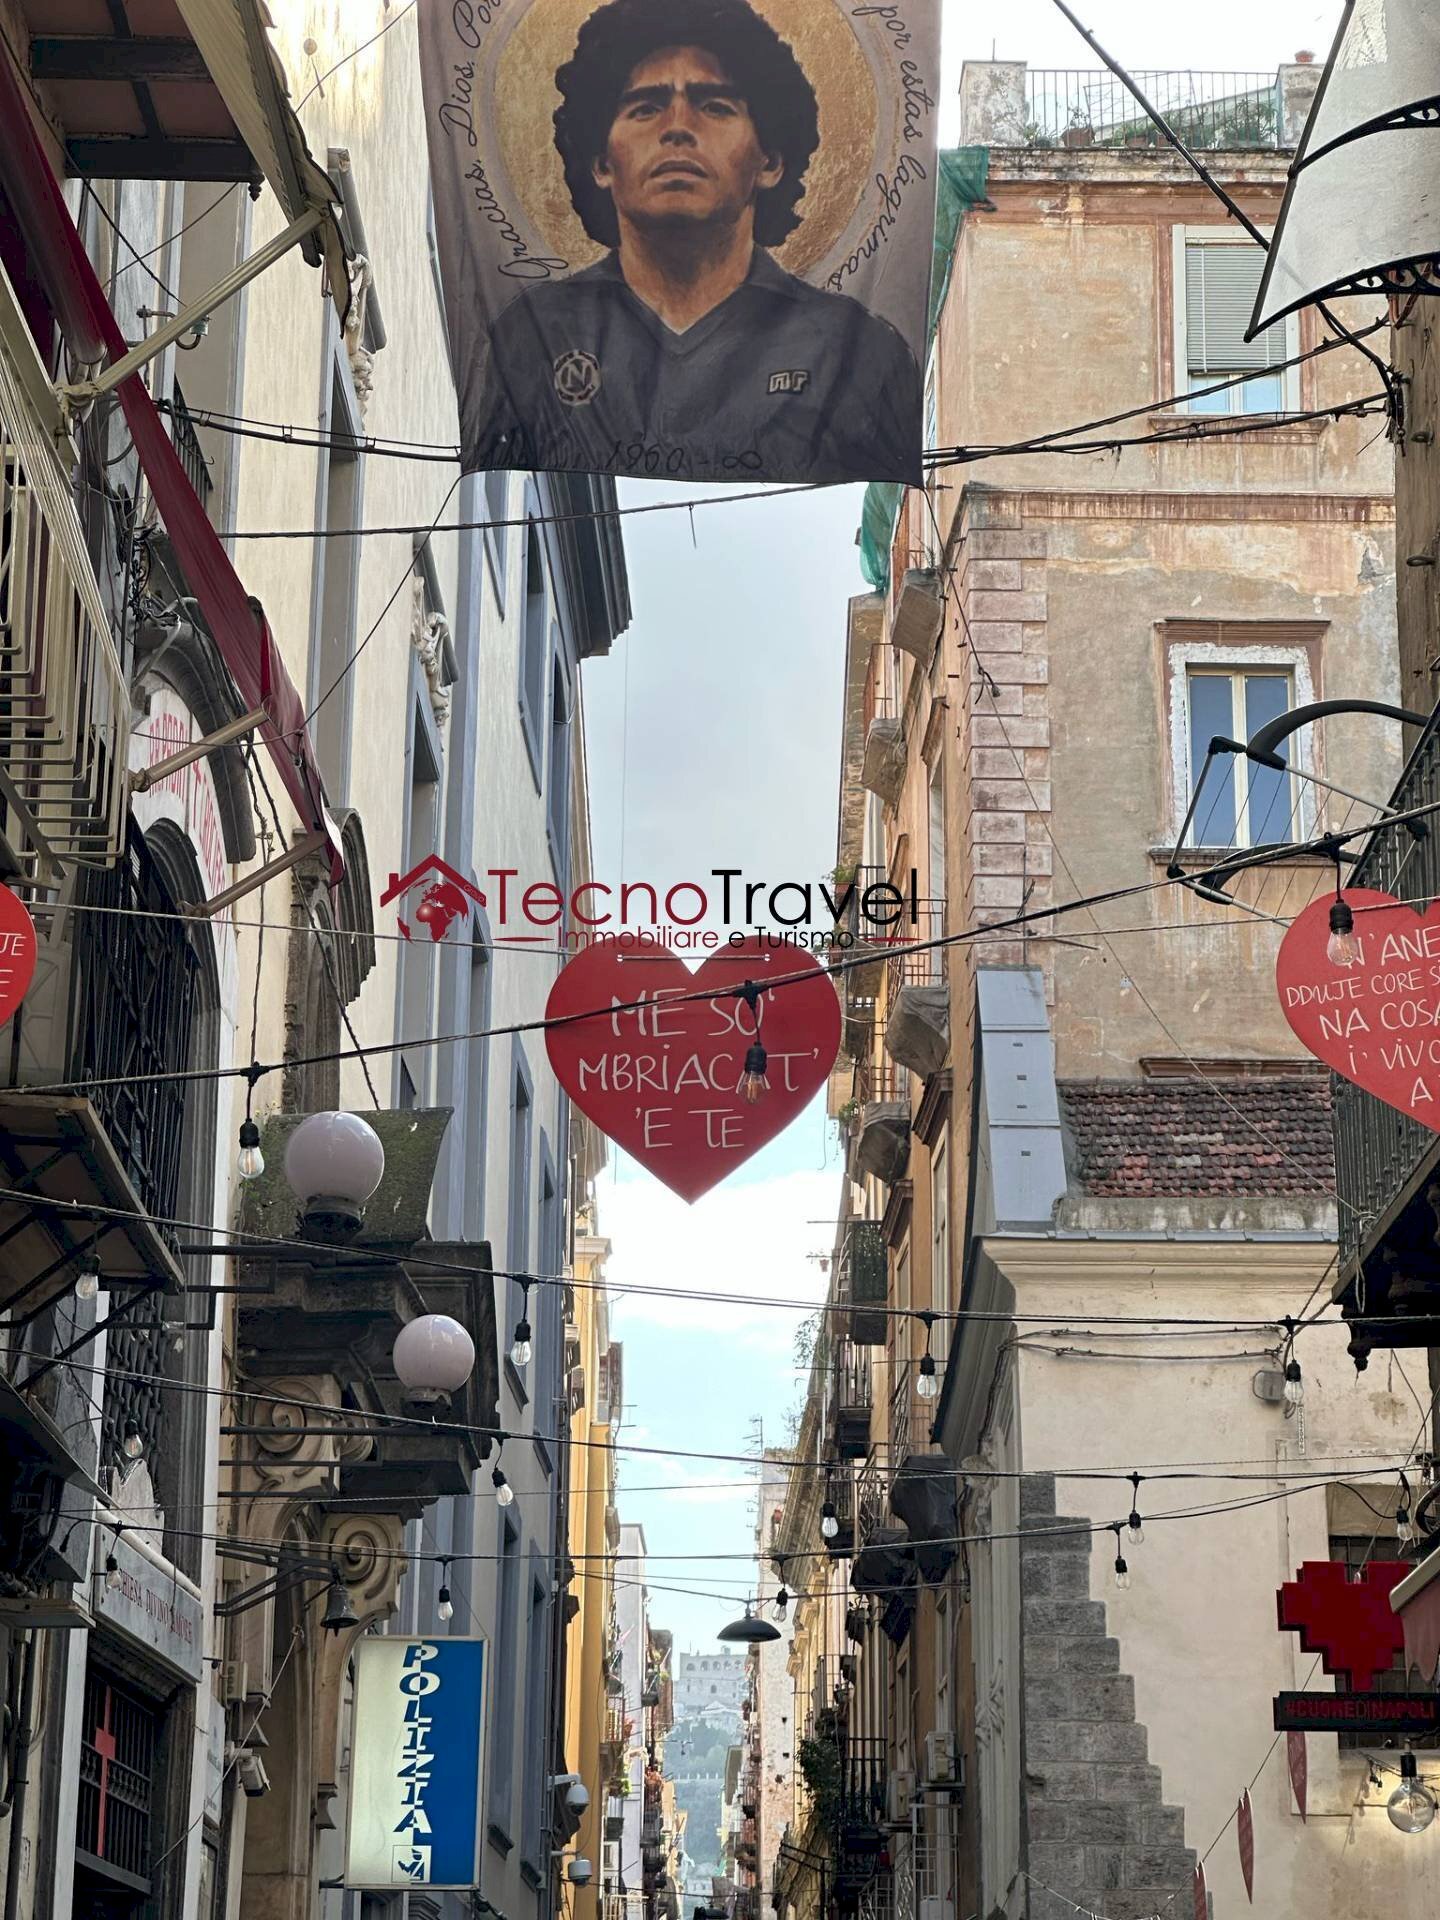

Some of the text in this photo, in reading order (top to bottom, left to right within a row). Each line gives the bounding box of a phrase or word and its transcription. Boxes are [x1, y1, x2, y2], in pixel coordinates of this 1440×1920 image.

[852, 5, 911, 50] por
[900, 60, 935, 143] estas
[605, 440, 684, 472] 1960
[1370, 968, 1425, 995] CORE
[611, 987, 687, 1037] ME
[1319, 1007, 1370, 1041] NA
[1410, 1076, 1434, 1107] A
[688, 1108, 745, 1149] TE
[119, 1568, 143, 1609] HIESA
[393, 1644, 441, 1833] POLIZIA
